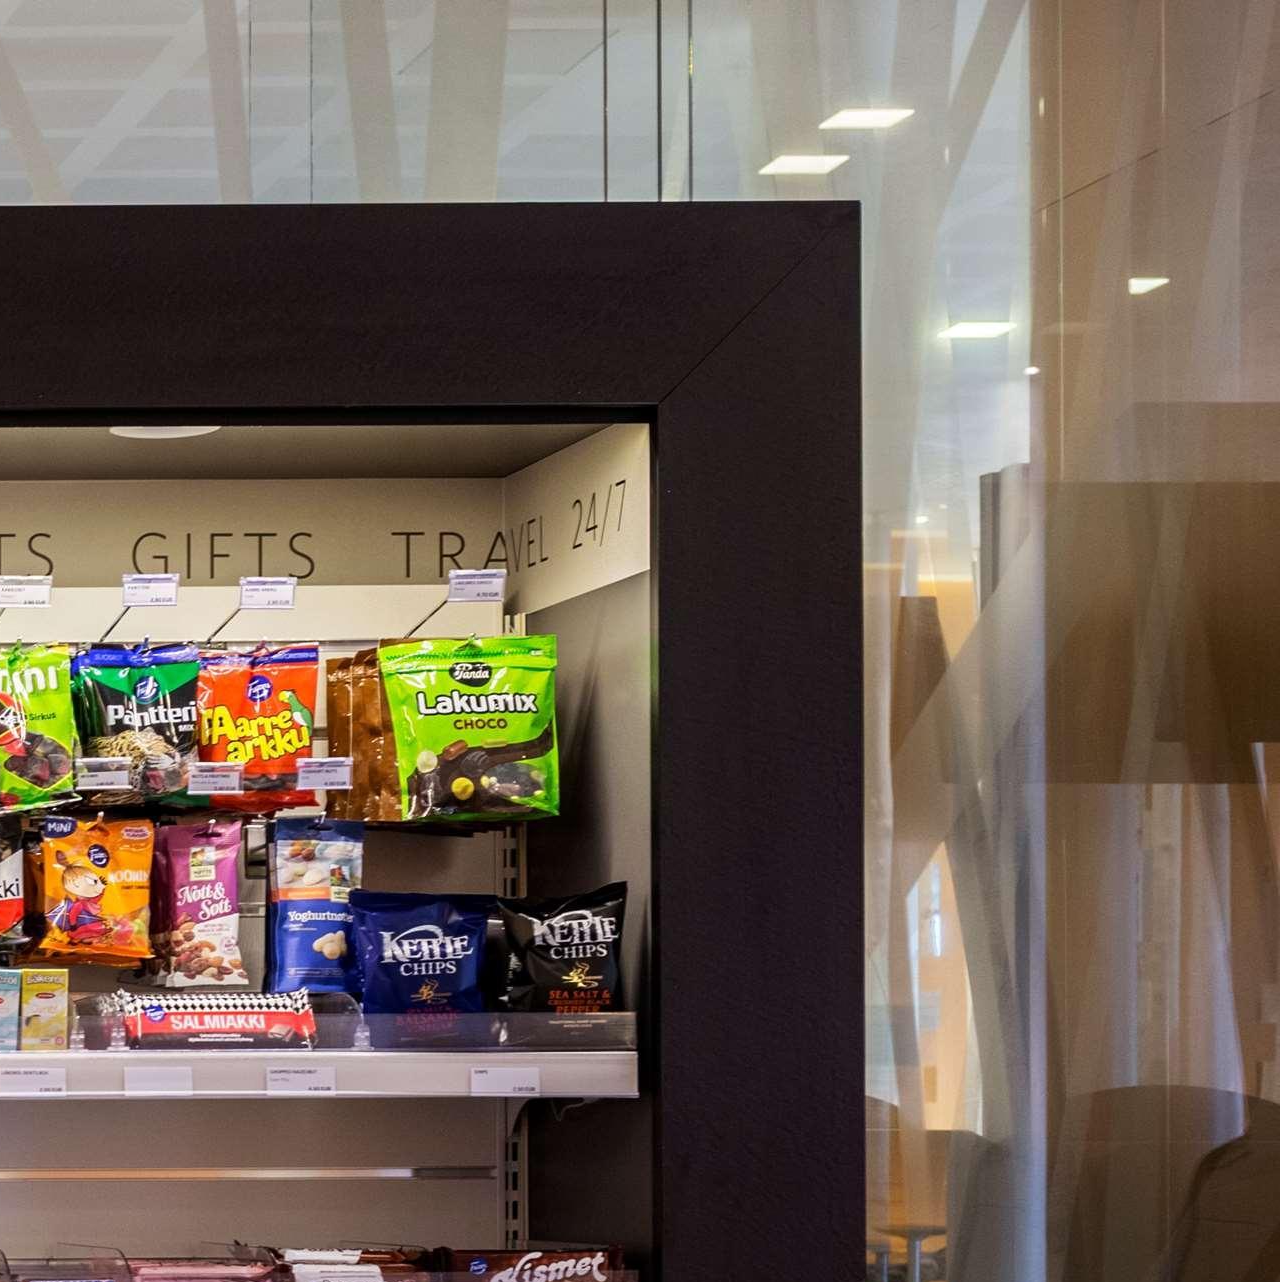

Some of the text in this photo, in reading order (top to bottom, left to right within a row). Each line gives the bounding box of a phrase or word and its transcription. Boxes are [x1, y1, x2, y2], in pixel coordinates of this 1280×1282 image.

[572, 479, 626, 550] 24/7
[131, 515, 549, 580] GIFTS TRAVEL
[417, 690, 538, 714] Lakumix
[29, 711, 57, 721] Sirkus
[453, 718, 508, 730] CHOCO
[531, 909, 620, 947] KETTLE
[378, 924, 474, 964] KETTLE
[549, 943, 609, 960] CHIPS
[399, 960, 458, 976] CHIPS
[170, 1014, 266, 1031] SALMIAKKI
